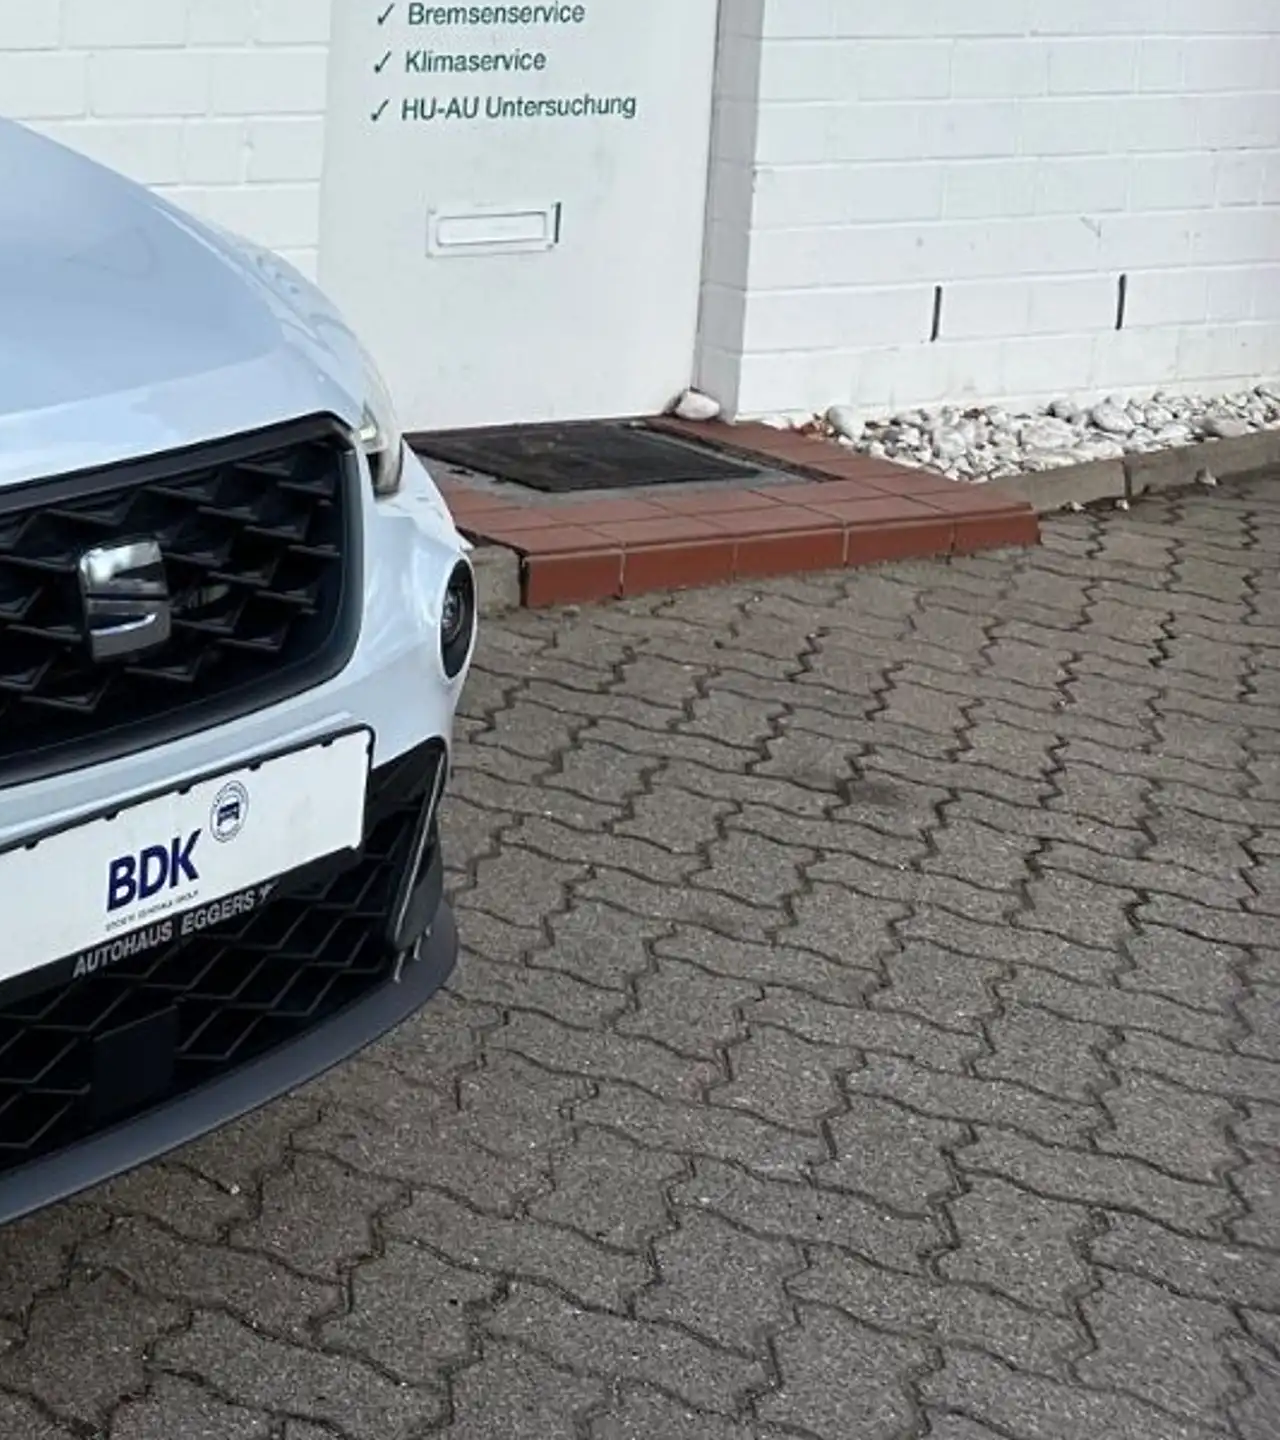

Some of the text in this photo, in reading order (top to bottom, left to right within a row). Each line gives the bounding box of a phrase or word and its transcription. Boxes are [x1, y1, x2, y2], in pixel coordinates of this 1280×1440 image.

[408, 0, 585, 26] Bremsenservice
[405, 48, 547, 73] Klimaservice
[401, 94, 637, 121] HU-AU Untersuchung
[106, 828, 201, 913] BDK
[72, 921, 173, 979] AUTOHAUS
[180, 888, 256, 937] EGGERS
